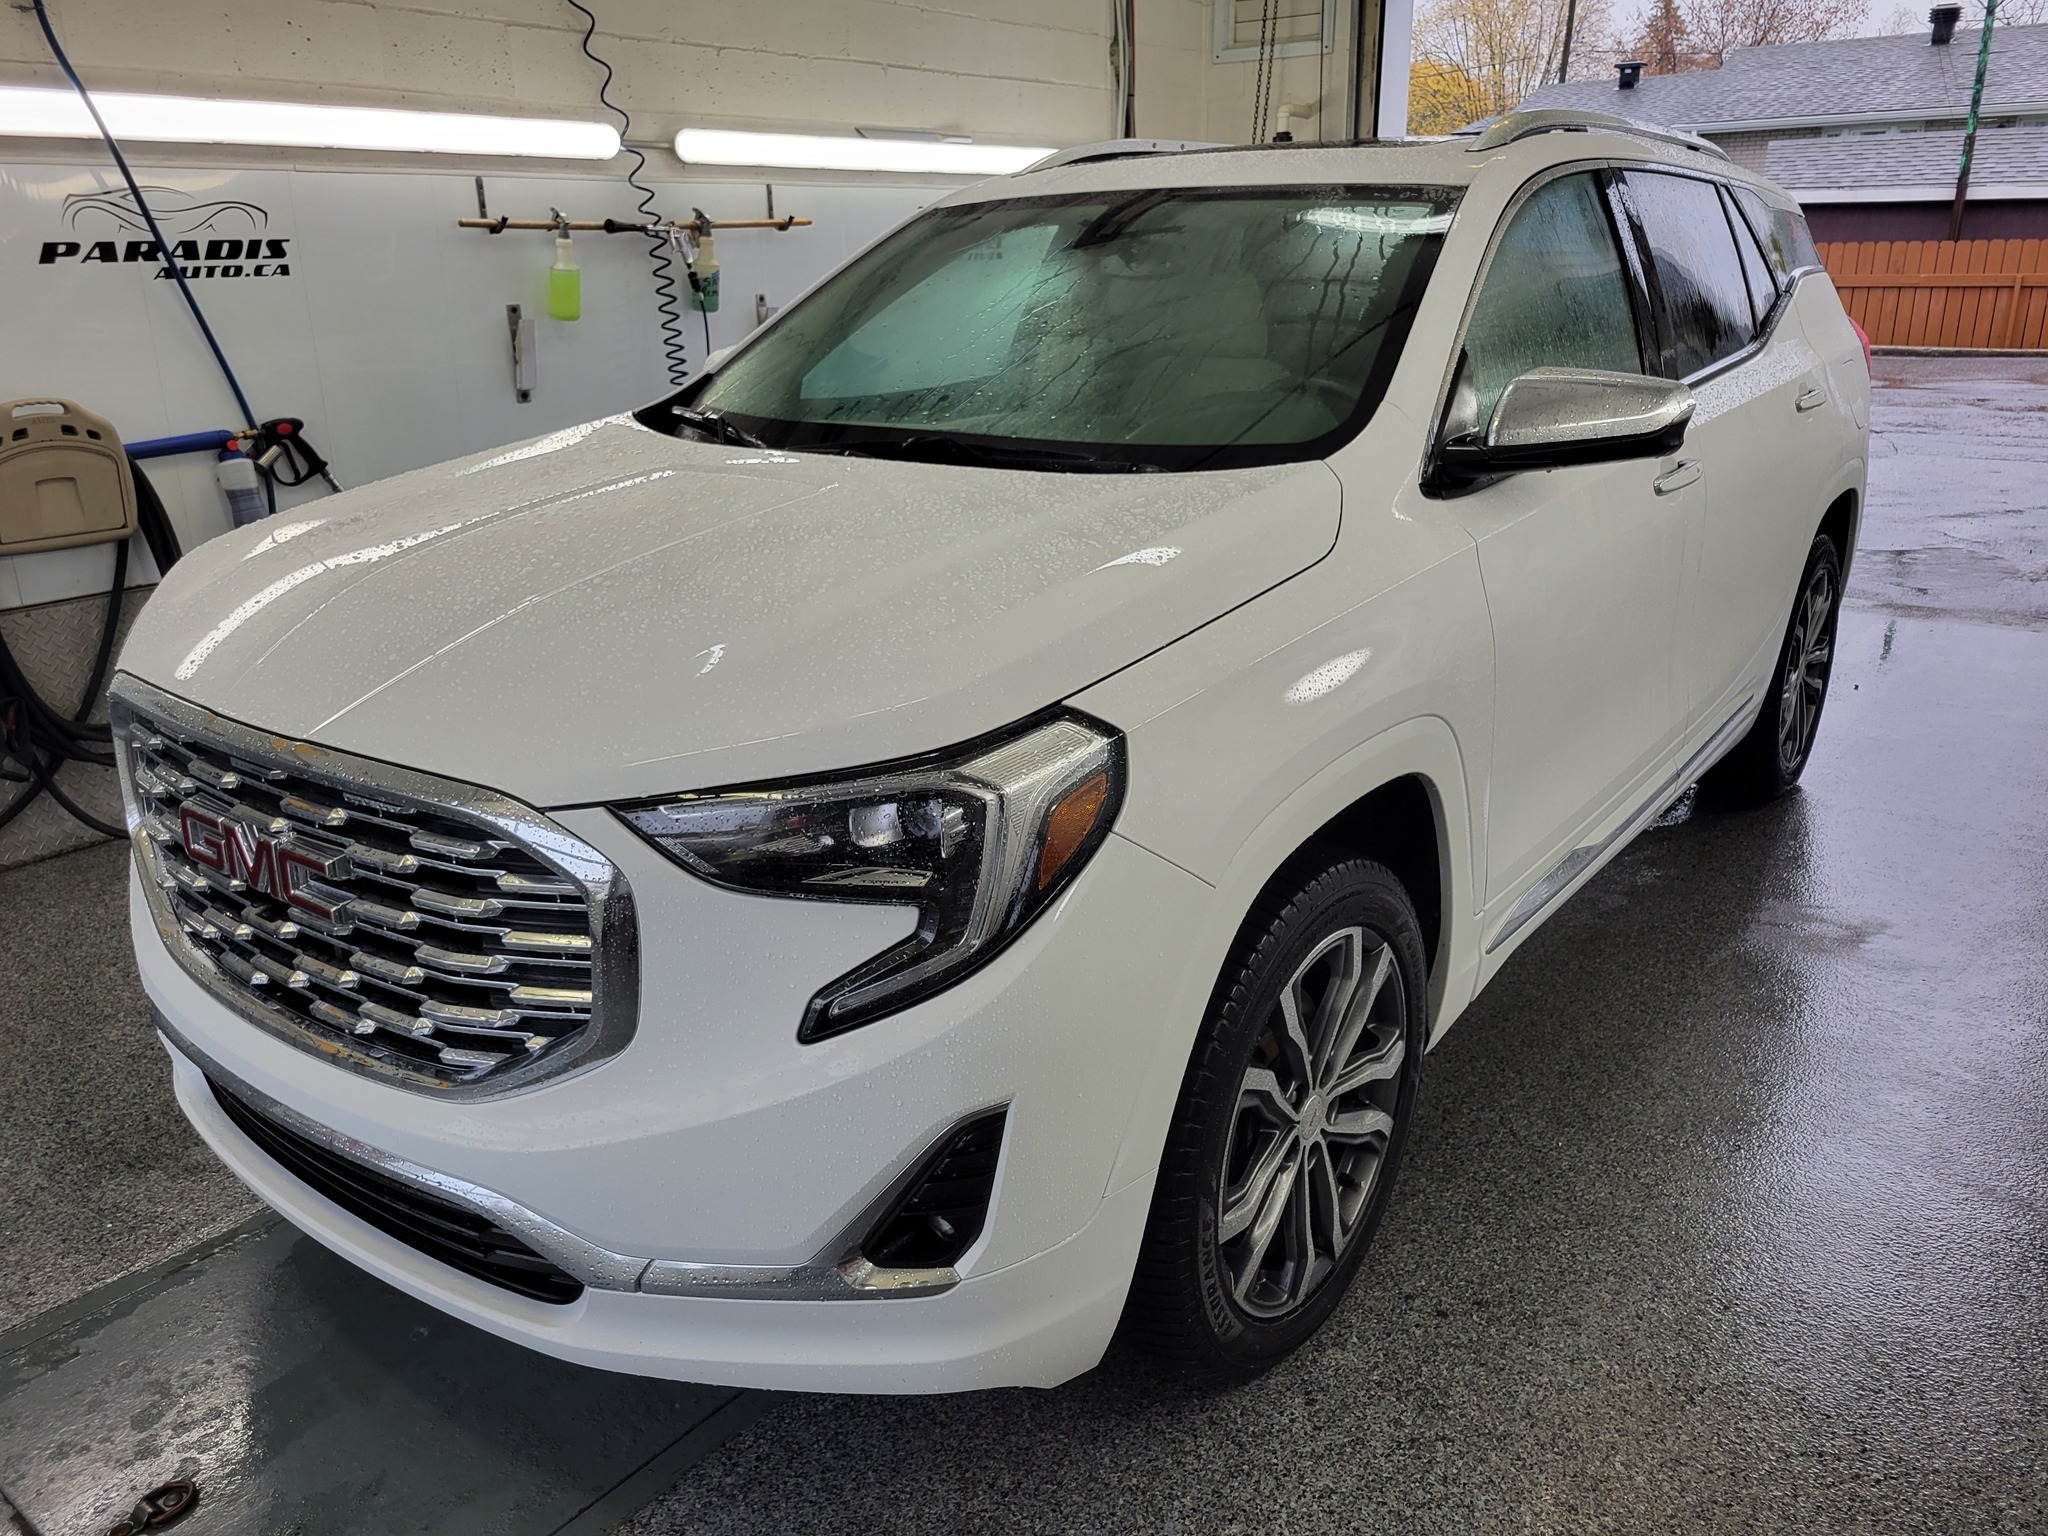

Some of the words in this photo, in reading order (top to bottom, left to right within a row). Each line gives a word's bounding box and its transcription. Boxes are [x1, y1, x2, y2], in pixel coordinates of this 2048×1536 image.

[38, 238, 291, 264] PARADIS
[153, 264, 291, 280] AUTO.CA
[178, 798, 348, 926] GMC
